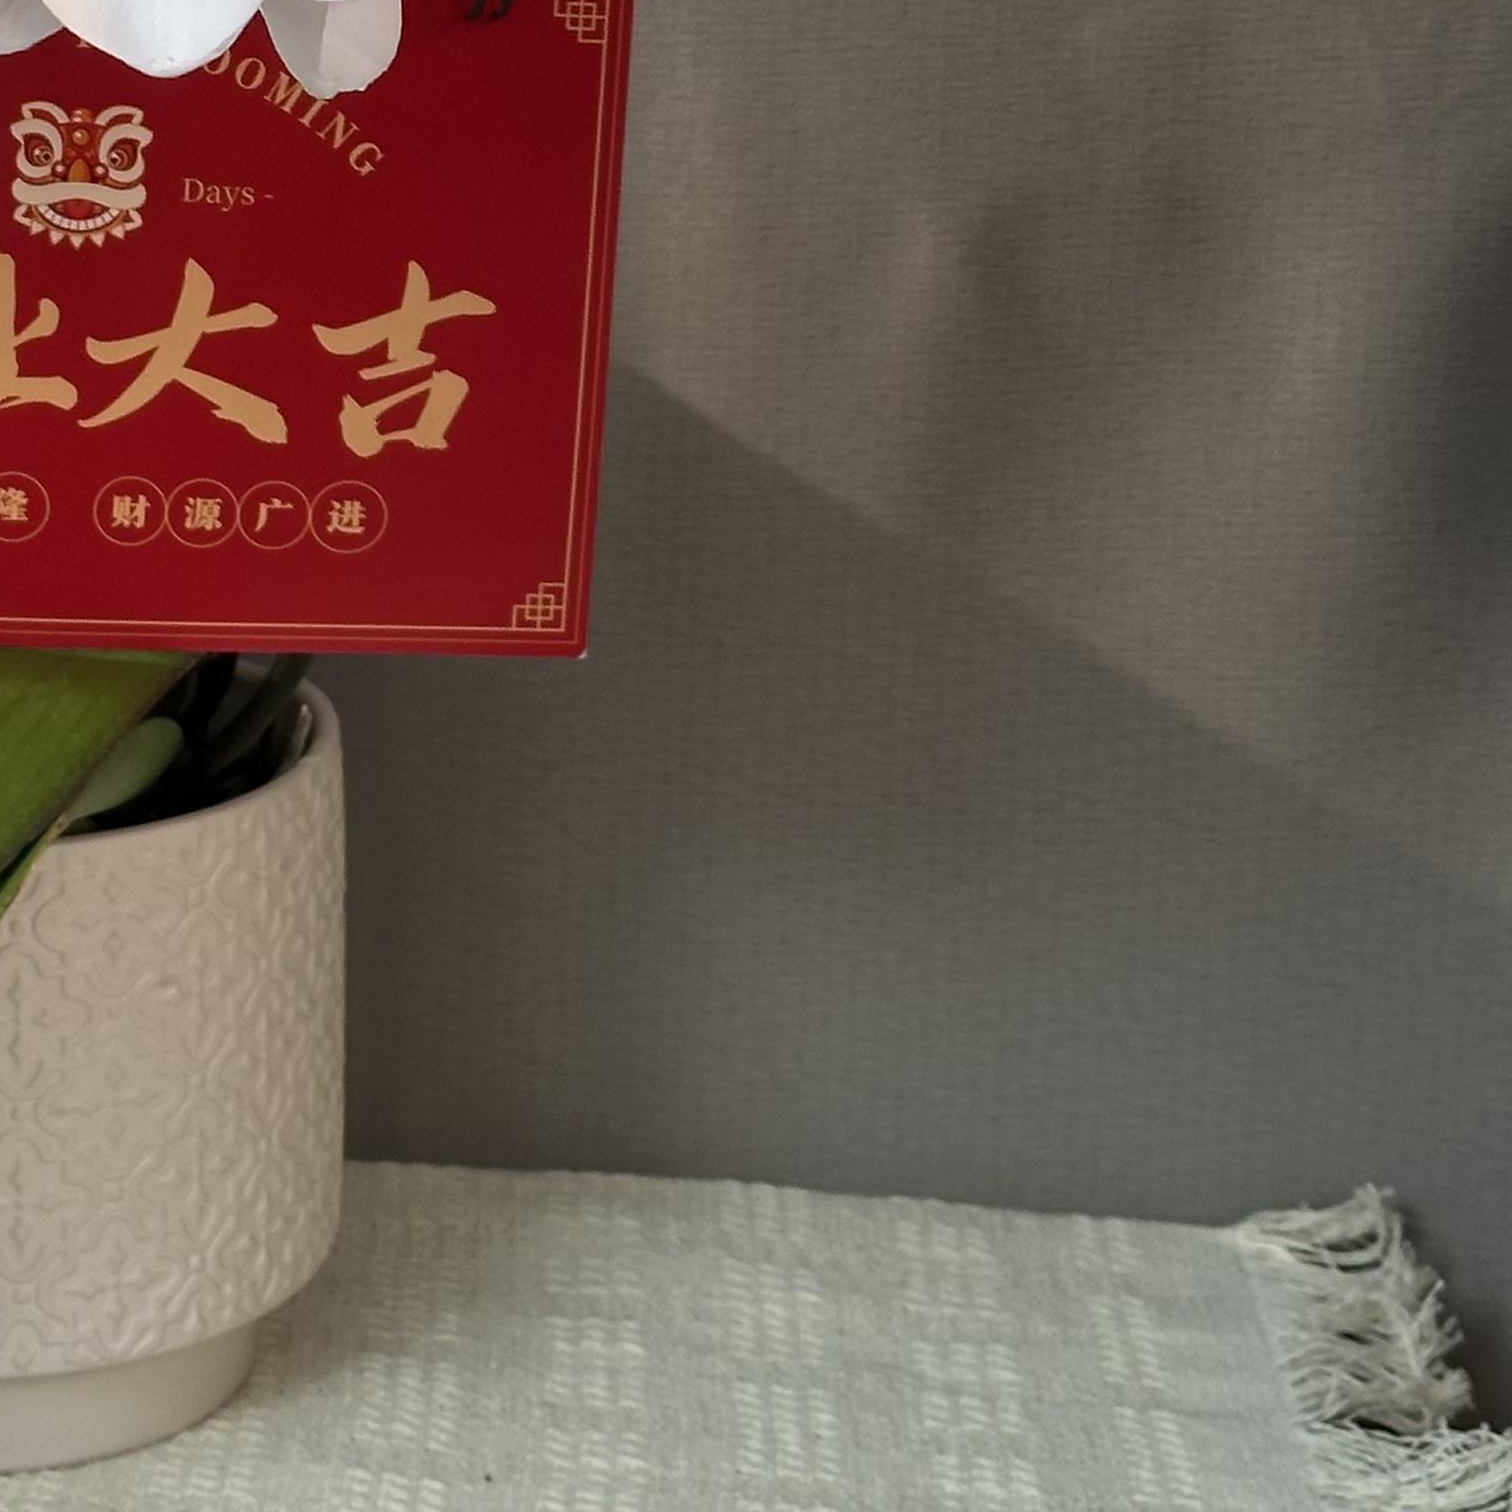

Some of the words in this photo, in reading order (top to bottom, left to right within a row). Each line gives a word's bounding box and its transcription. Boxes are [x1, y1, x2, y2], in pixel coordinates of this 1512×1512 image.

[182, 176, 256, 213] Days
[110, 493, 367, 535] 财源广进
